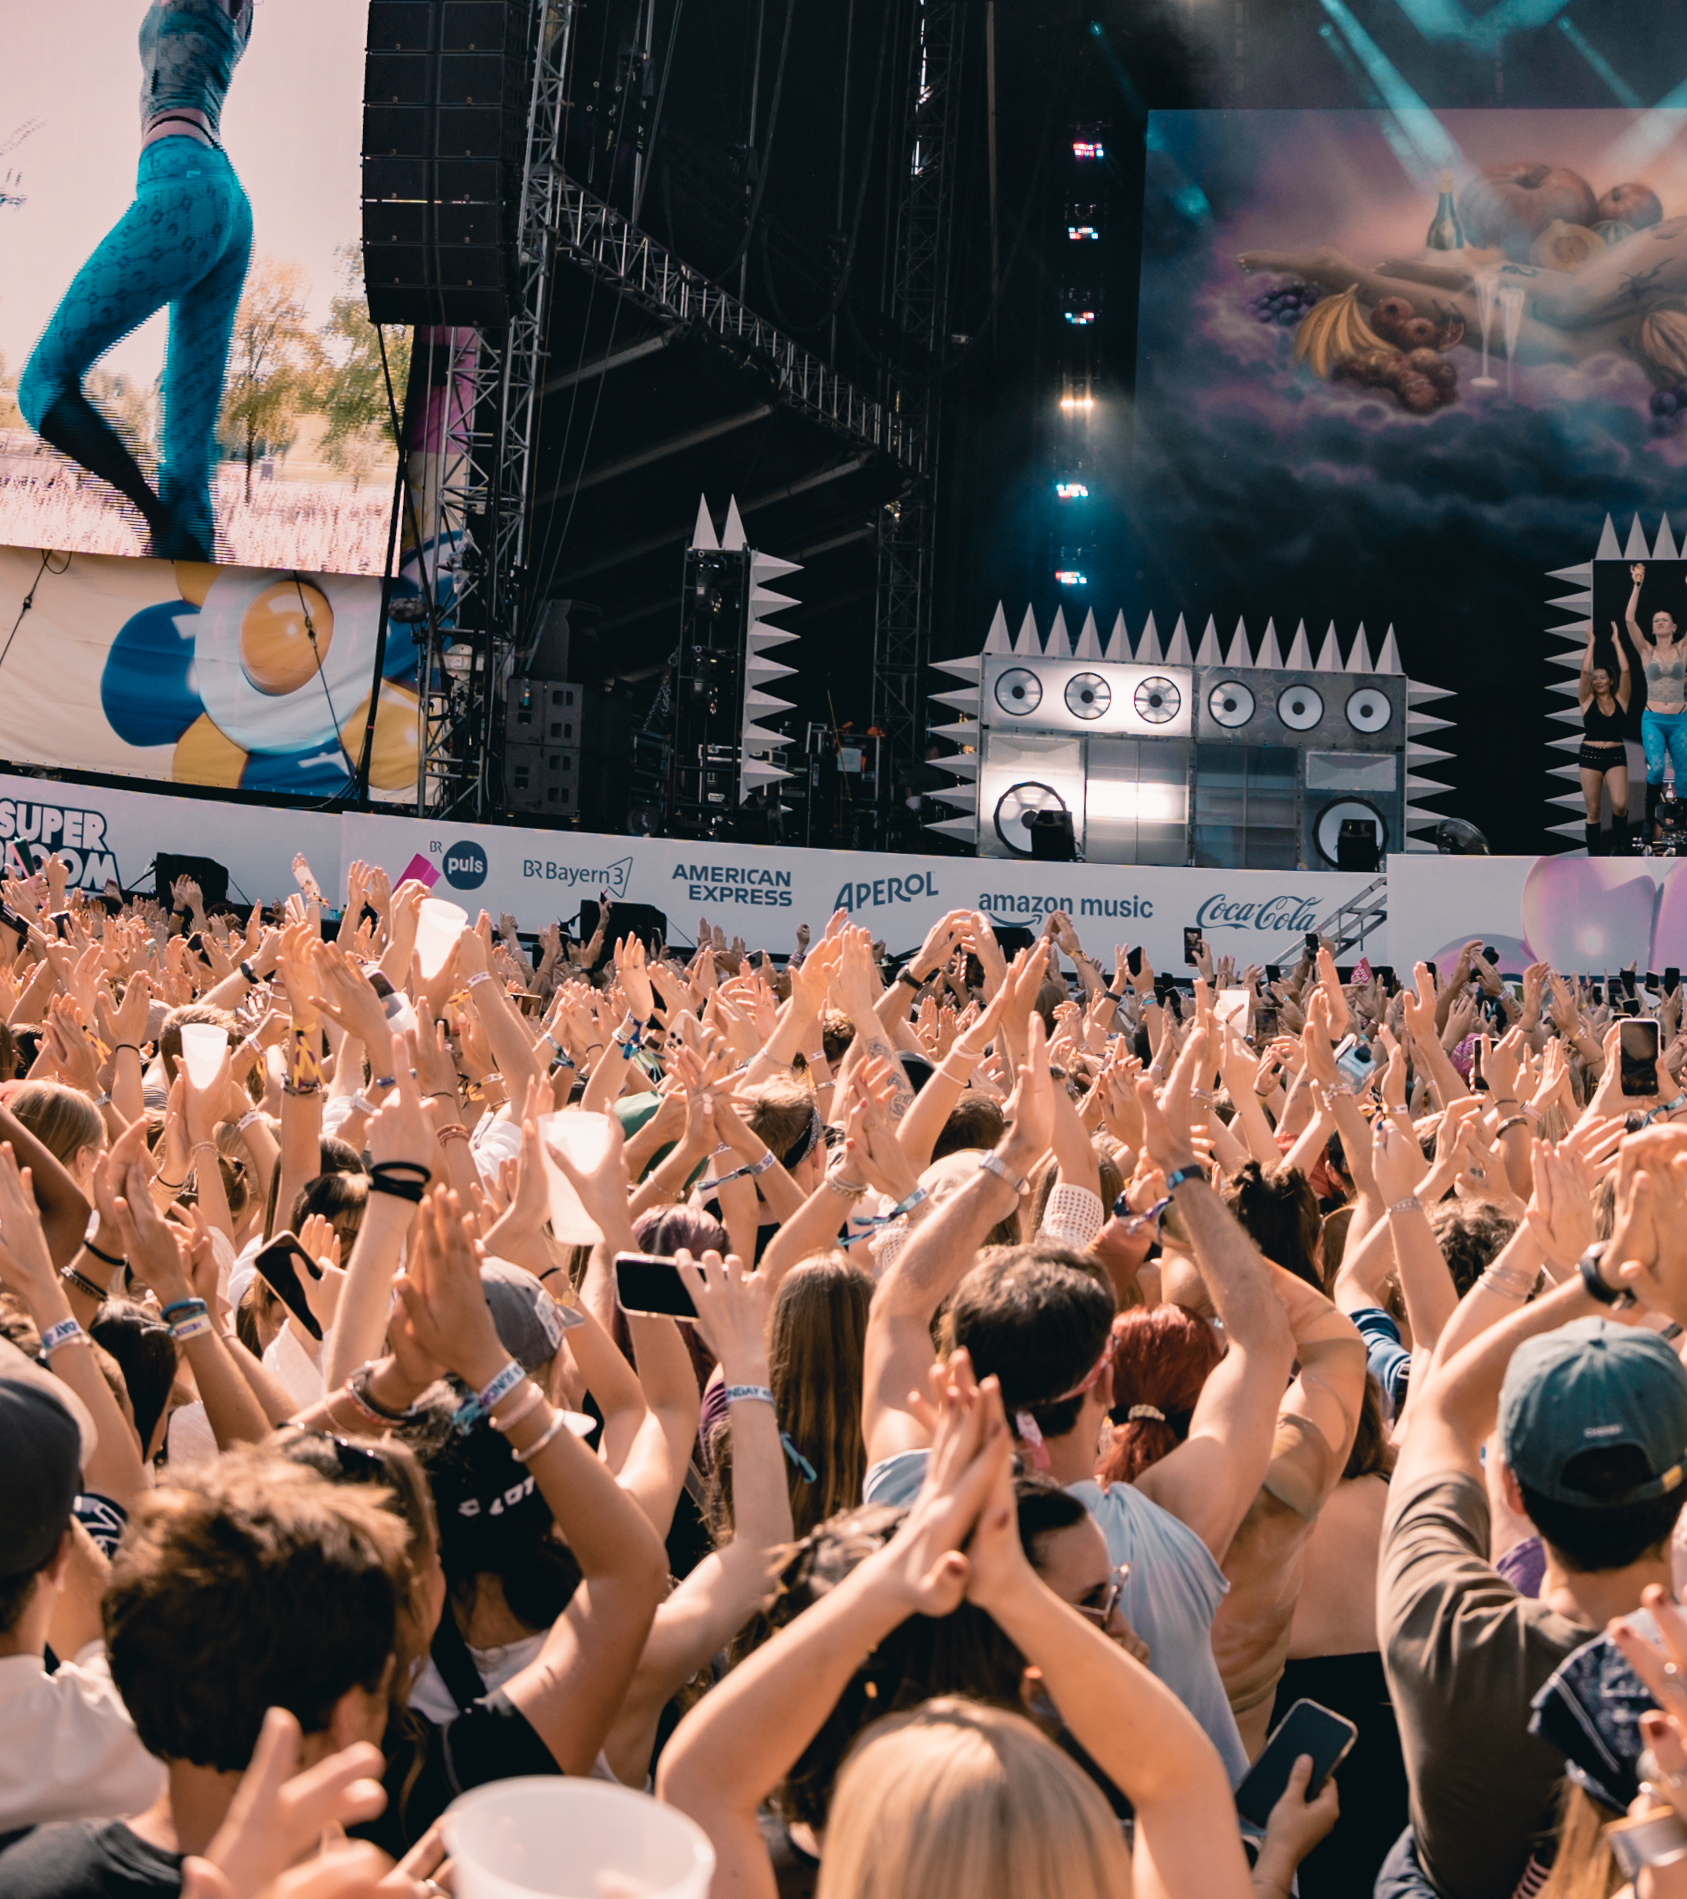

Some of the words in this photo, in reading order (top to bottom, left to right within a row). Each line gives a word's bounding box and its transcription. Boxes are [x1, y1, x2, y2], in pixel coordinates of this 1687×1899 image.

[430, 841, 443, 854] BR
[447, 855, 484, 876] puls
[545, 860, 610, 887] Bayern
[611, 867, 624, 886] 3
[672, 864, 792, 888] AMERICAN
[688, 884, 793, 907] EXPRESS
[834, 871, 940, 914] APEROL
[979, 892, 1073, 919] amazon
[1080, 896, 1153, 919] music
[1196, 894, 1324, 932] Coca-Cola
